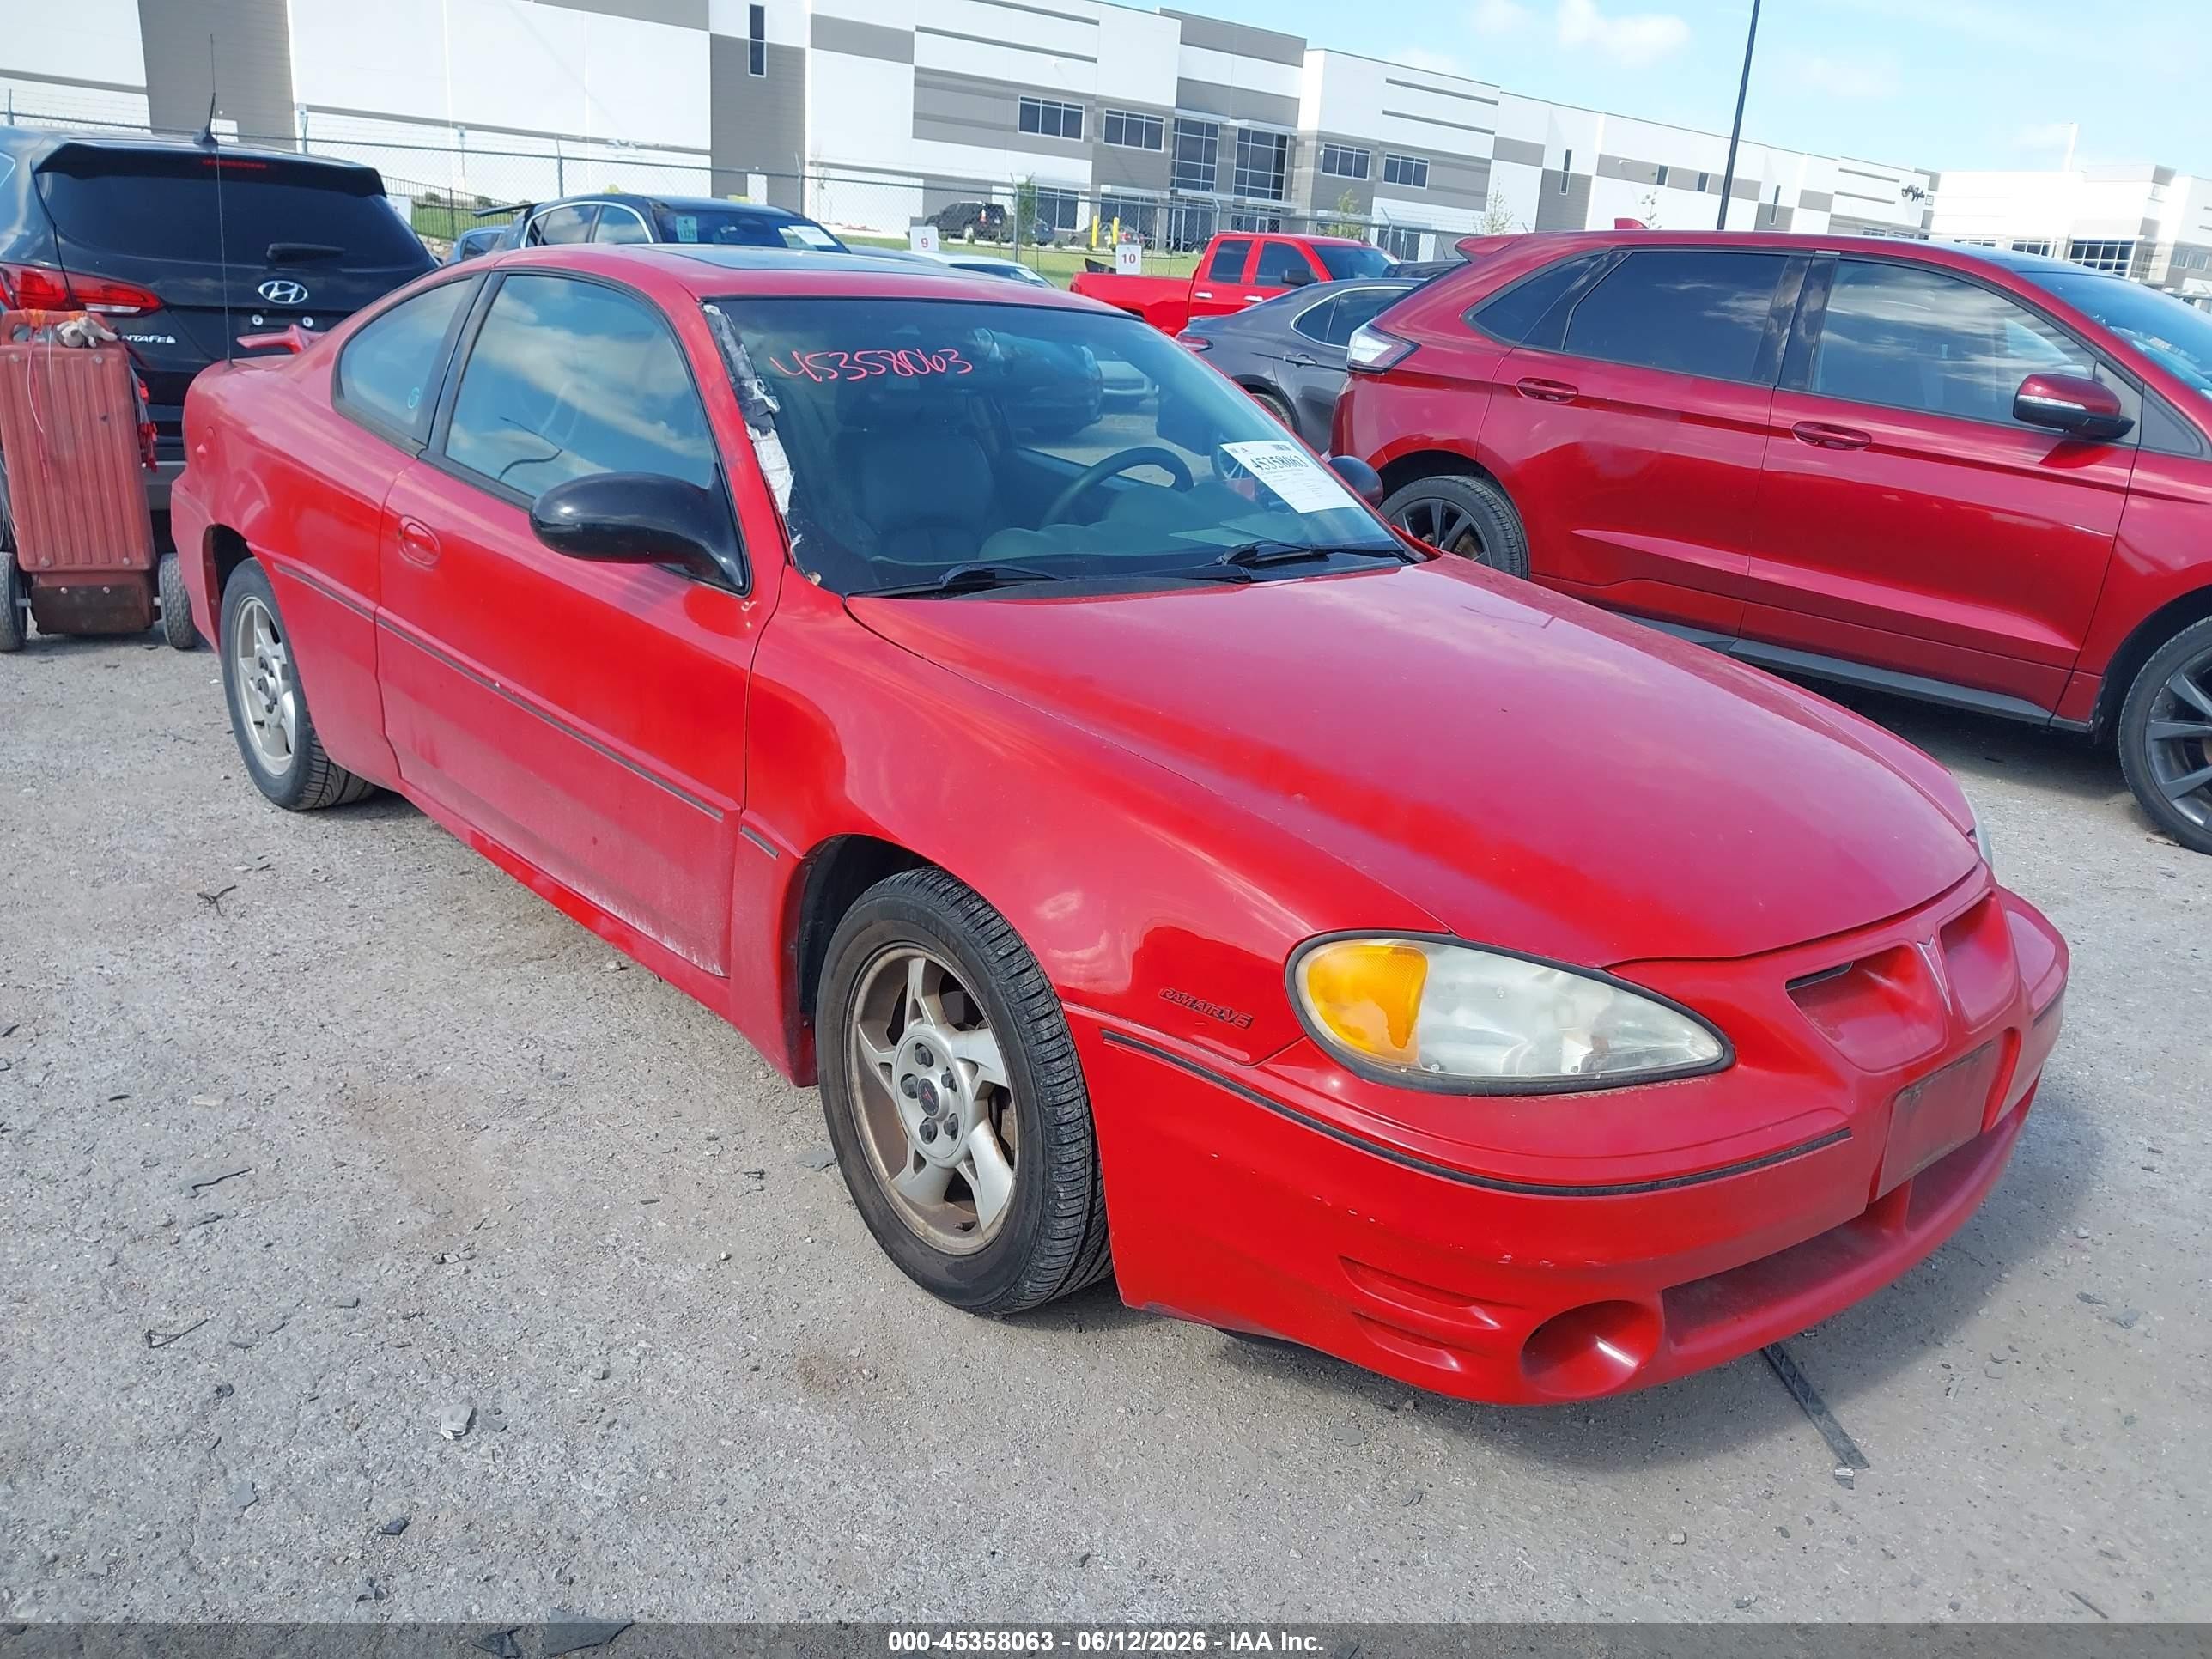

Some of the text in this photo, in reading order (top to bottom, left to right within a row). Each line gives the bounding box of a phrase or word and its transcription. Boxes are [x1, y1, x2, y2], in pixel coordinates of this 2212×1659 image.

[920, 237, 928, 247] 9
[1121, 253, 1136, 264] 10
[769, 349, 973, 382] 45358063
[1160, 988, 1251, 1028] RAM AIR V6
